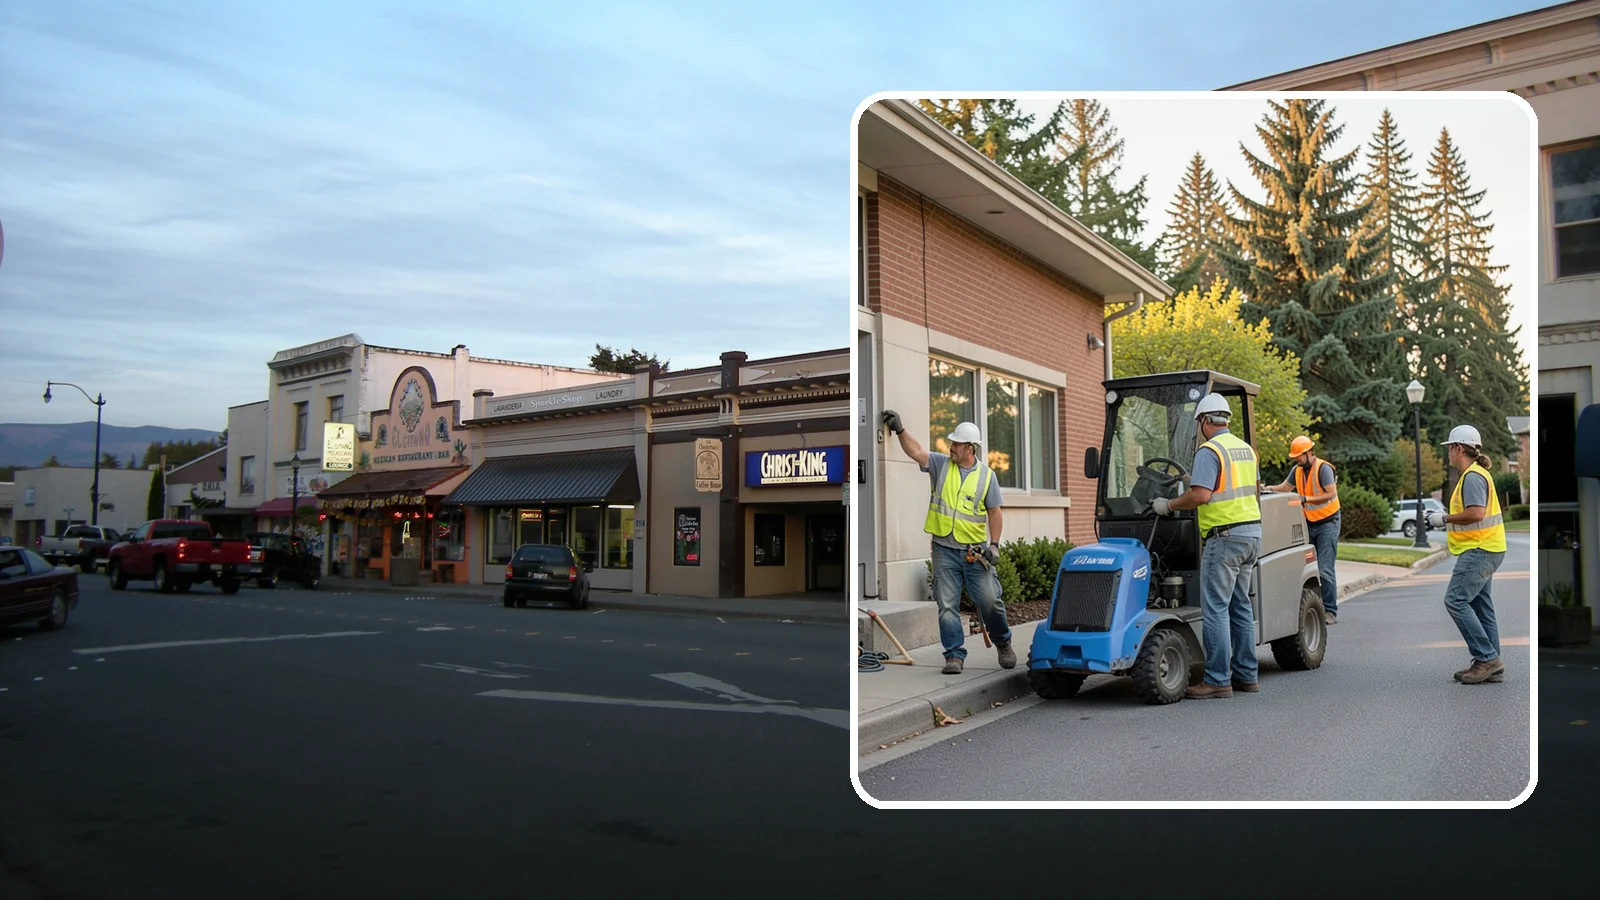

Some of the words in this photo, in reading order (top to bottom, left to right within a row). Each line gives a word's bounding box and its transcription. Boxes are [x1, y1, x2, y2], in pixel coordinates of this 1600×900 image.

[595, 389, 623, 400] LAUNDRY
[493, 402, 522, 413] LAVANDERIA
[398, 451, 433, 462] RESTAURANT
[438, 450, 450, 459] BAR
[761, 452, 797, 478] CHRIST
[799, 450, 827, 476] KING
